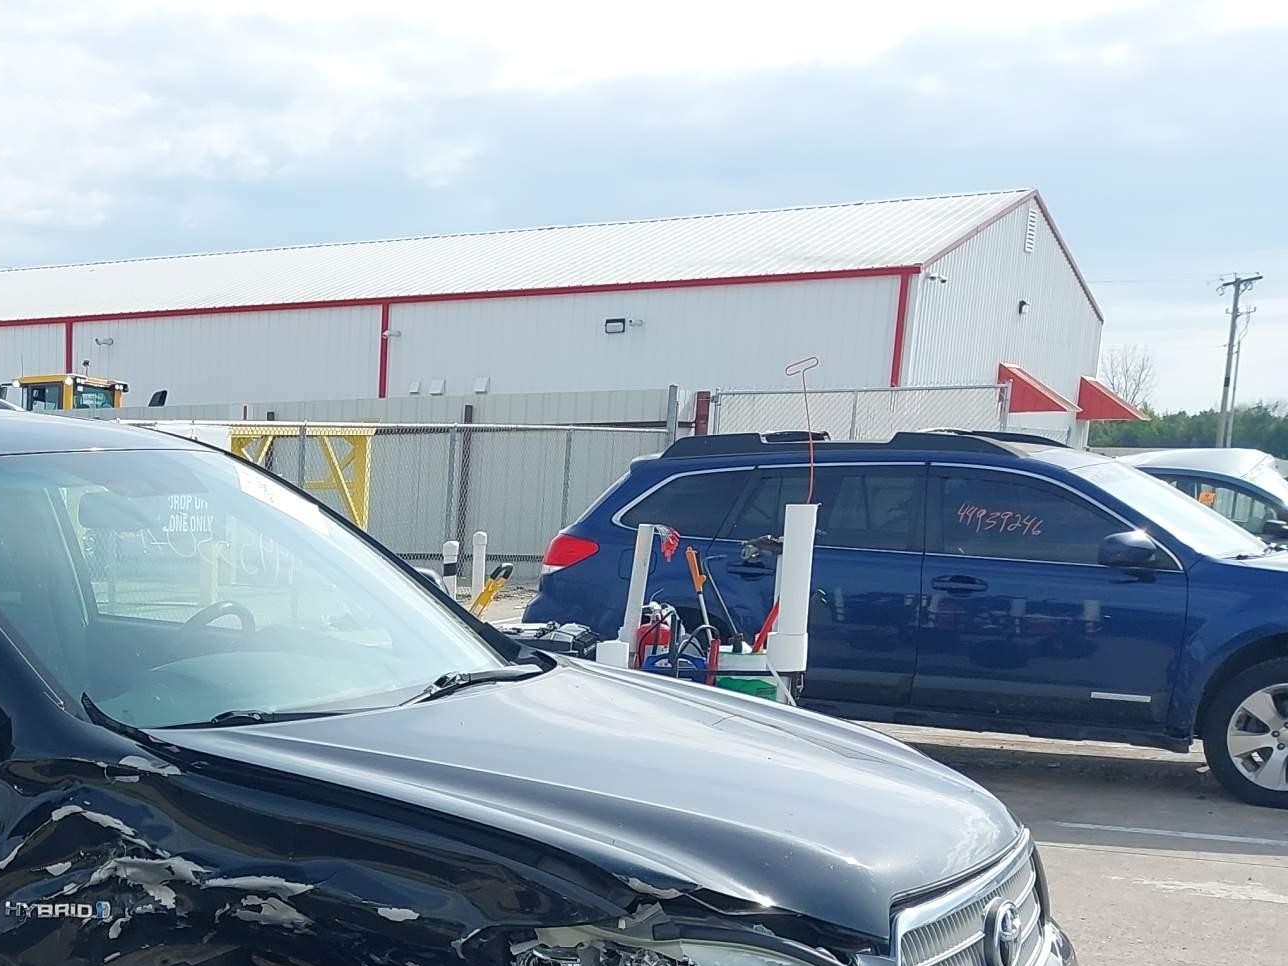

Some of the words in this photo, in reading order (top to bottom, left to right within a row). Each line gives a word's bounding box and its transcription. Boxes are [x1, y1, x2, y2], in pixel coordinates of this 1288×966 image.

[163, 514, 189, 532] ONE
[190, 514, 214, 532] ONLY
[957, 503, 1044, 535] 44939246
[5, 901, 93, 918] HYBRID
